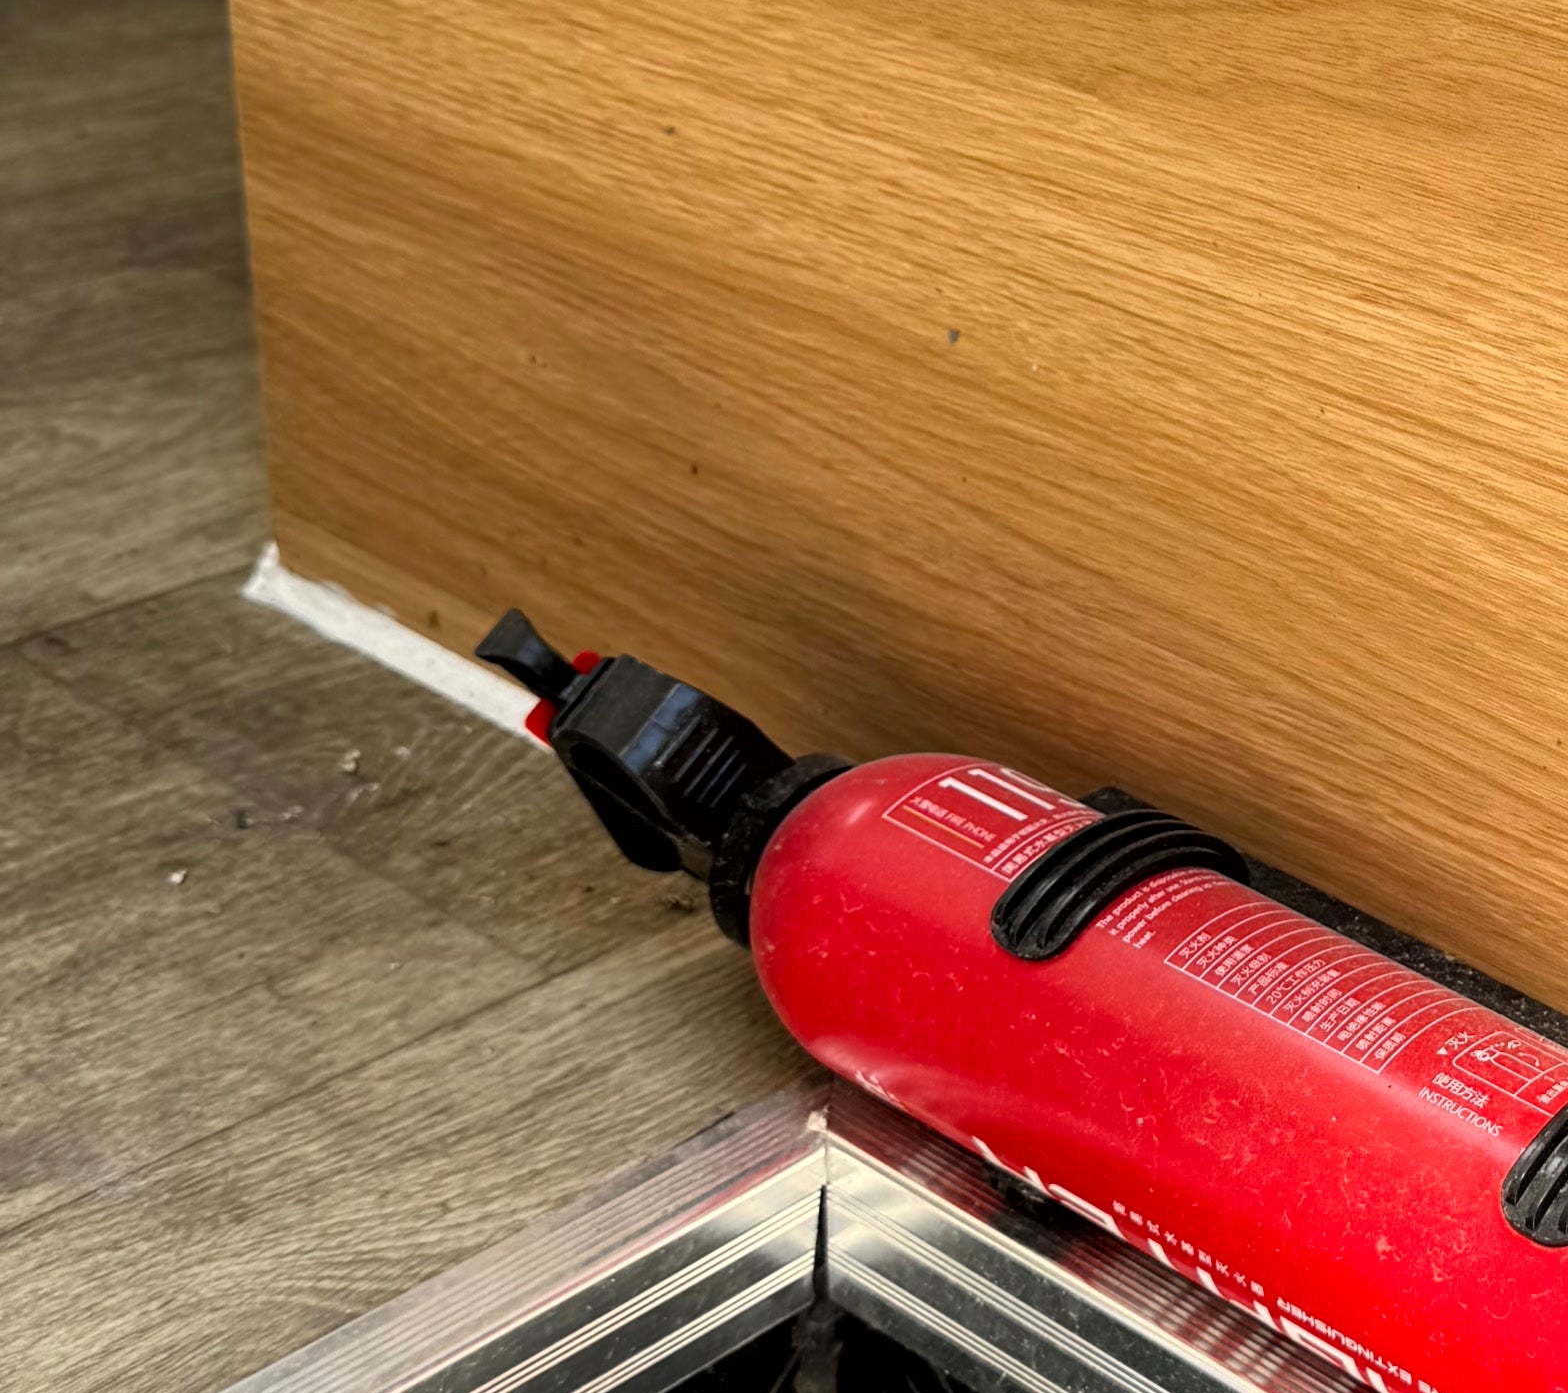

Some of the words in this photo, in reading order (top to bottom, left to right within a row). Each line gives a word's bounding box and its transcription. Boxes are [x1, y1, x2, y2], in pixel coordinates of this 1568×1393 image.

[963, 820, 997, 842] PHONE
[1122, 919, 1147, 943] power
[1445, 1031, 1476, 1050] 灭火
[1432, 1072, 1491, 1108] 使用方法
[1418, 1086, 1503, 1137] INSTRUCTIONS
[1277, 1296, 1412, 1386] EXTINGUISHER
